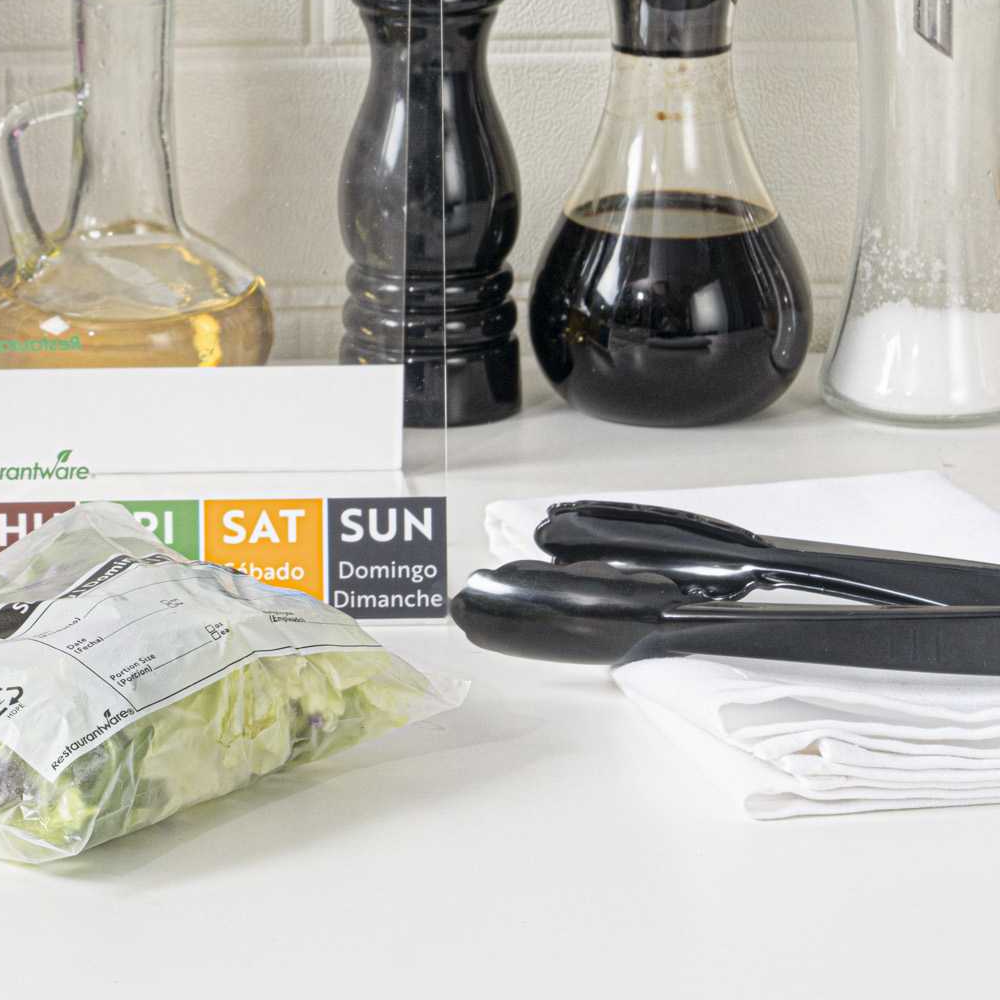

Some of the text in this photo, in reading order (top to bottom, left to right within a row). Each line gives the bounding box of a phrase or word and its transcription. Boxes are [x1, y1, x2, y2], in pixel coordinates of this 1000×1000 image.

[133, 511, 174, 545] RI
[222, 508, 306, 543] SAT
[340, 507, 433, 542] SUN
[338, 561, 438, 581] Domingo
[334, 590, 443, 609] Dimanche
[66, 637, 87, 651] Date
[109, 653, 157, 682] Portion Size
